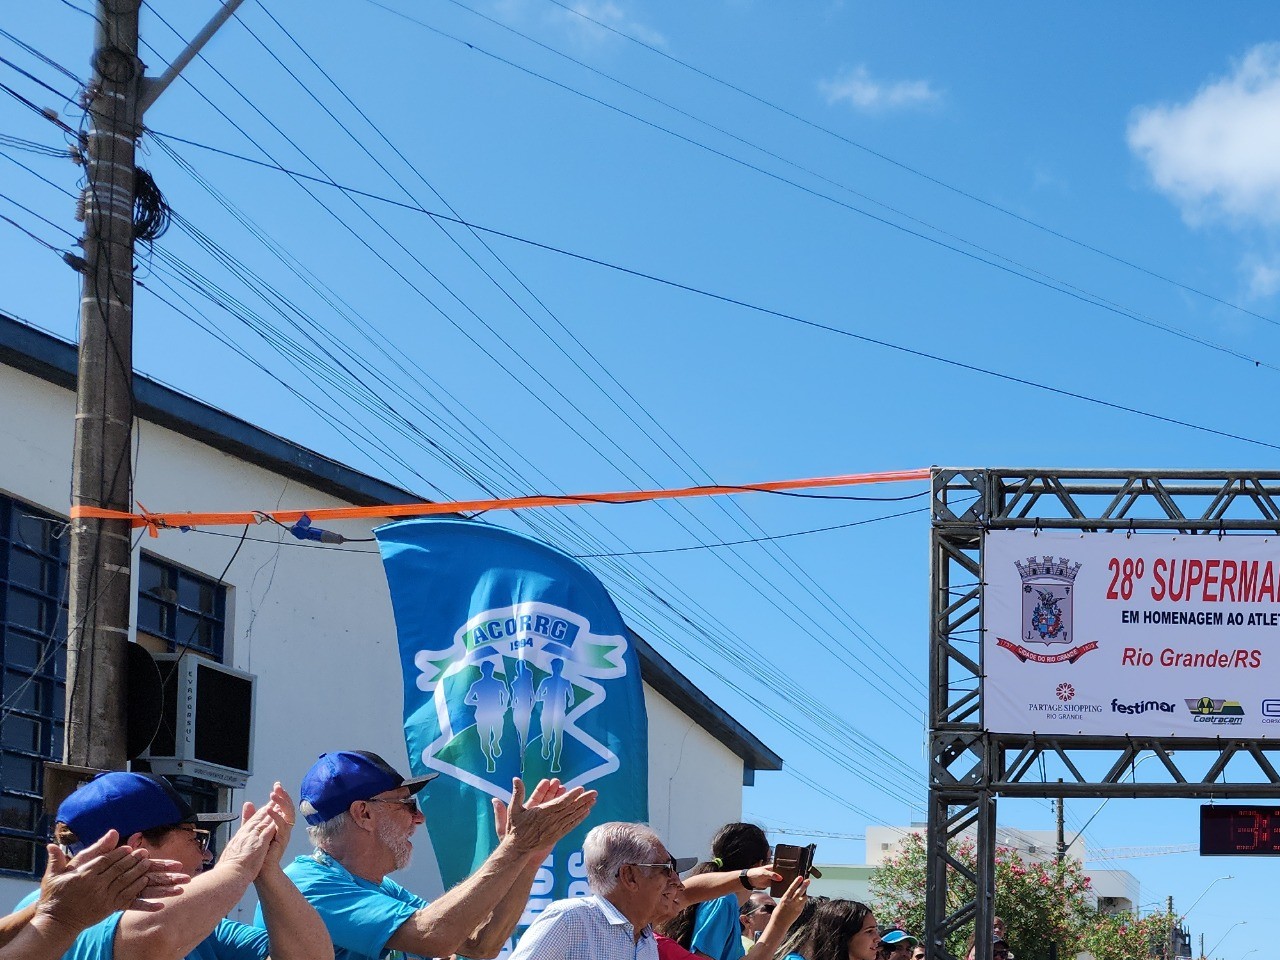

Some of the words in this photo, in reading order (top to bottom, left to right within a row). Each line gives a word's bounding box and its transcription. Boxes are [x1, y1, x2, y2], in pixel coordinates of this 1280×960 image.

[1106, 557, 1145, 601] 28º
[1121, 610, 1140, 624] EM
[1143, 610, 1223, 626] HOMENAGEM
[1226, 612, 1244, 626] AO
[472, 613, 569, 647] ACORRG
[509, 637, 534, 651] 1994
[1121, 647, 1154, 667] Rio
[1160, 648, 1262, 668] Grande/RS
[1028, 703, 1063, 712] PARTAGE
[1063, 704, 1103, 713] SHOPPING
[1110, 698, 1176, 714] festimar
